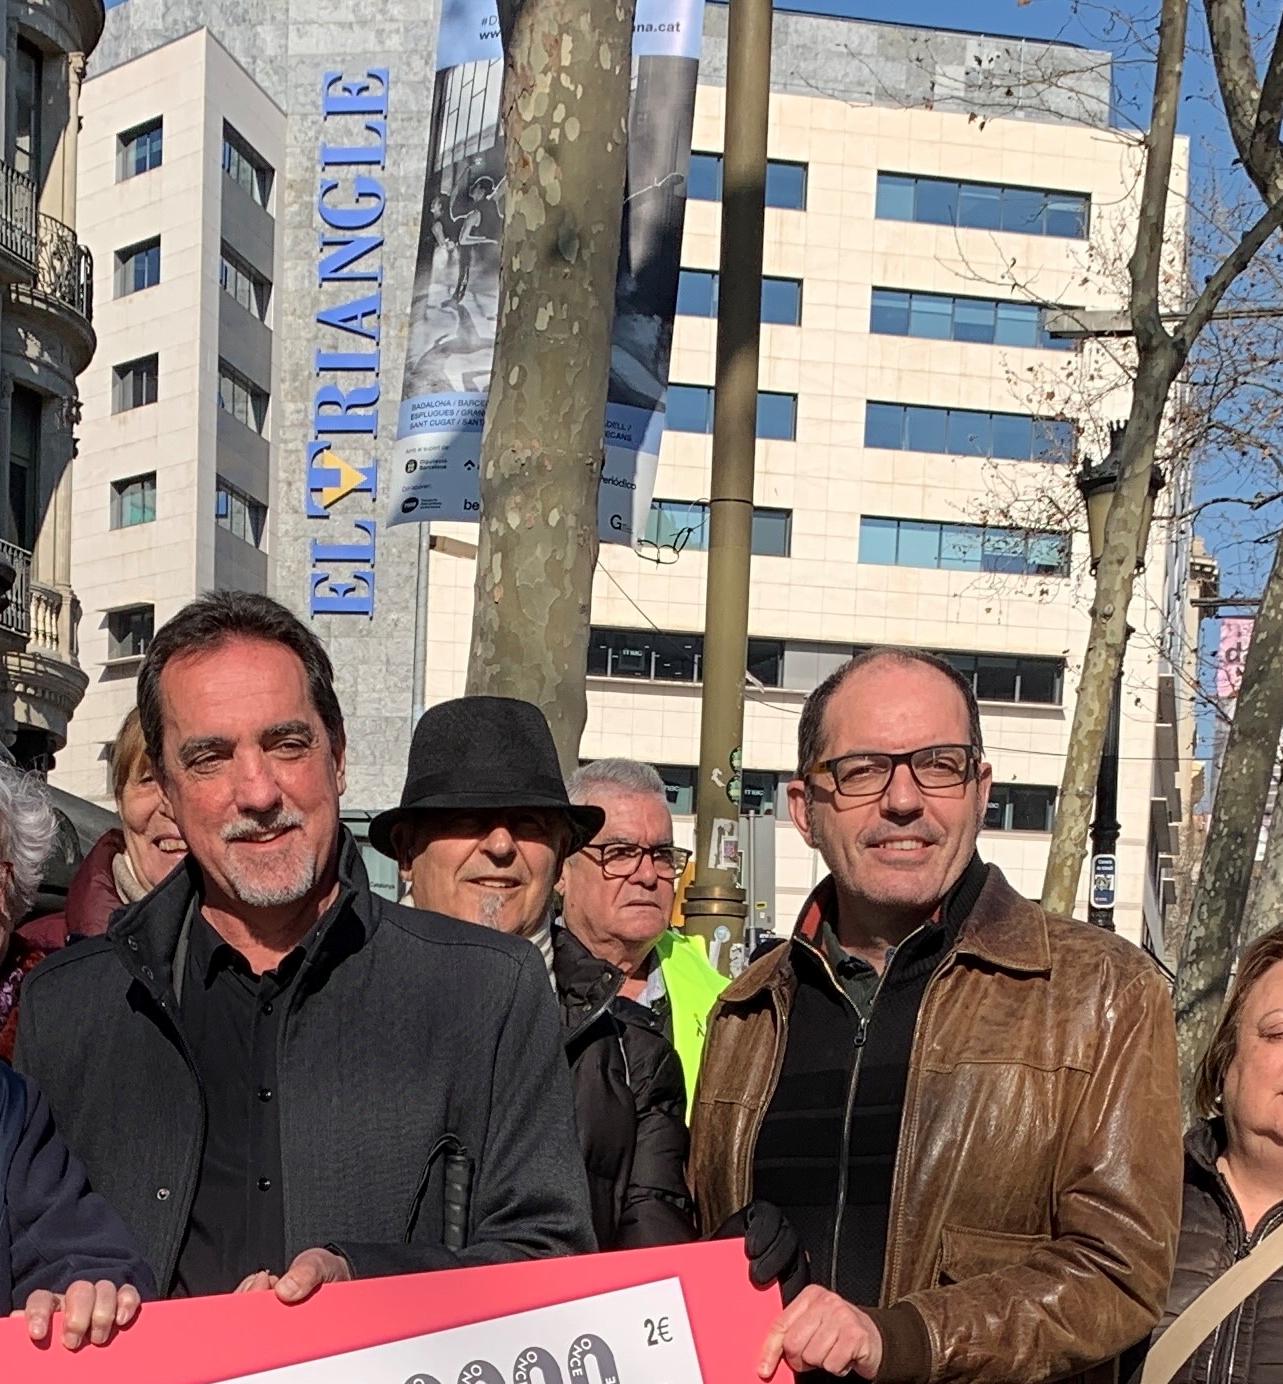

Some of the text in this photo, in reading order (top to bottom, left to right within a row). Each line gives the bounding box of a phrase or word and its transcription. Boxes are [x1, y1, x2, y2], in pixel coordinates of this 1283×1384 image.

[632, 21, 681, 33] na.cat
[305, 68, 390, 621] EL TRIANGLE
[605, 420, 626, 432] DELL
[643, 1316, 673, 1347] 2€
[570, 1338, 592, 1377] ONCE
